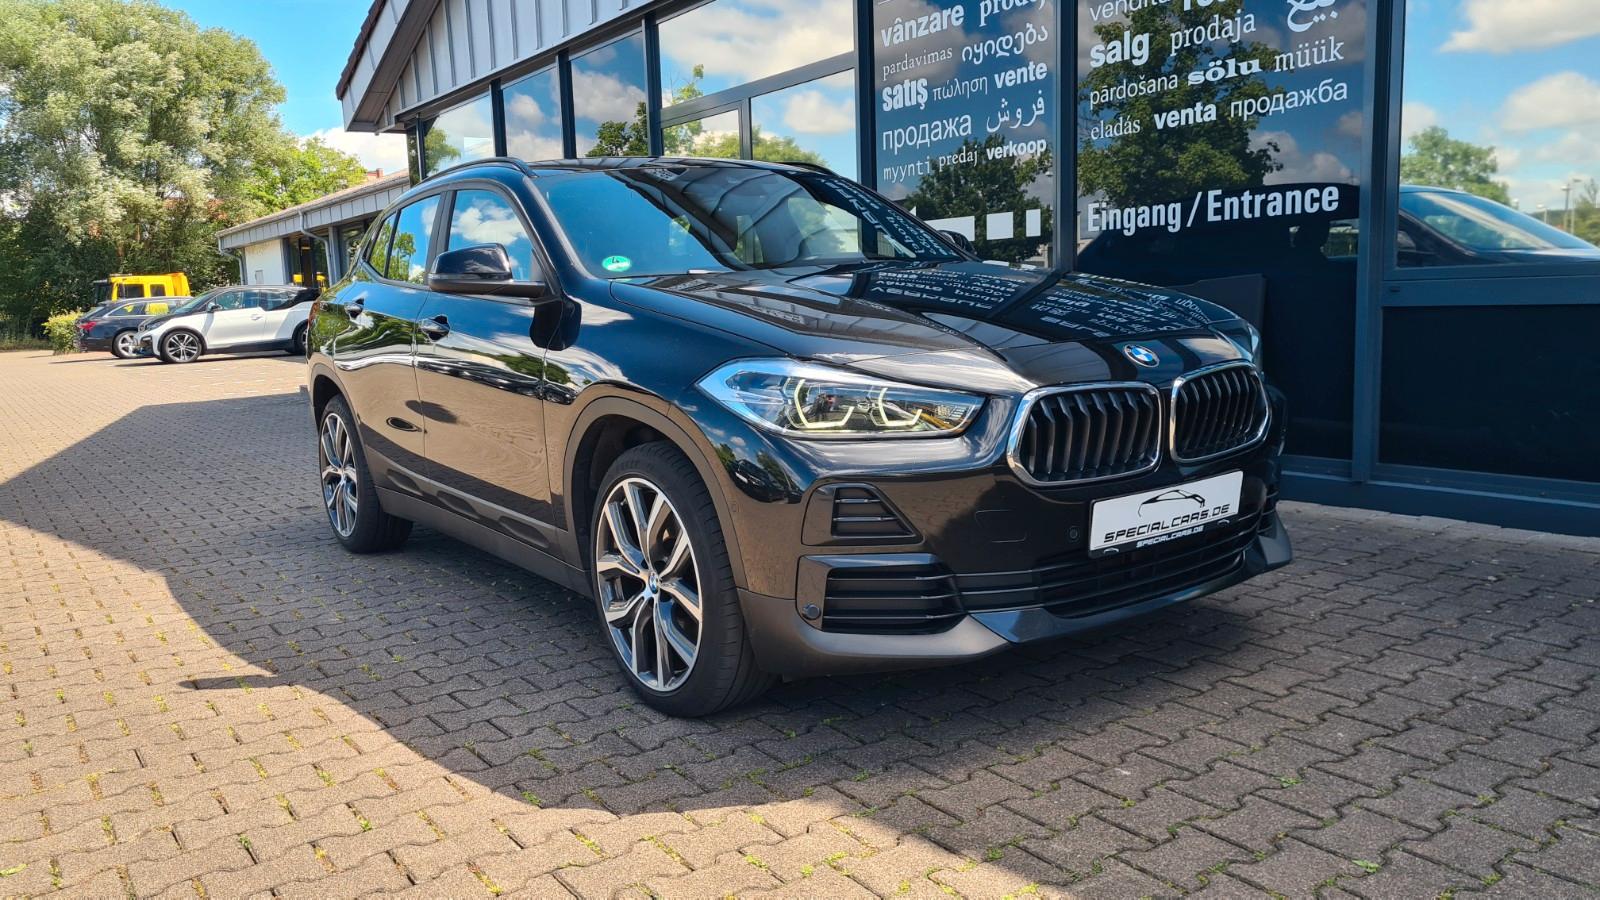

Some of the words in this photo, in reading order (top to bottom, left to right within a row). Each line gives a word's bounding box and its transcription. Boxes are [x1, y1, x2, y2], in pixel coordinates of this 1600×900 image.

[880, 4, 965, 48] vânzare
[961, 22, 1049, 65] იყიდება
[1089, 30, 1150, 68] salg
[1170, 9, 1256, 57] prodaja
[882, 46, 953, 81] pardavimas
[994, 60, 1048, 89] vente
[1090, 72, 1178, 111] pārdošana
[1187, 57, 1263, 87] sölu
[1273, 36, 1345, 73] müük
[882, 78, 928, 112] satış
[932, 75, 988, 102] πώληση
[1230, 78, 1348, 122] продажба
[986, 89, 1045, 133] فروش
[1090, 116, 1141, 141] eladás
[1153, 103, 1217, 130] venta
[882, 114, 972, 156] продажа
[883, 156, 930, 184] myynti
[939, 145, 979, 173] predaj
[986, 138, 1047, 161] verkoop
[1087, 201, 1182, 236] Eingang
[1207, 185, 1340, 222] Entrance
[1103, 503, 1231, 543] SPECIALCARS.DE
[1135, 525, 1205, 548] SPECIALCARS.DE
